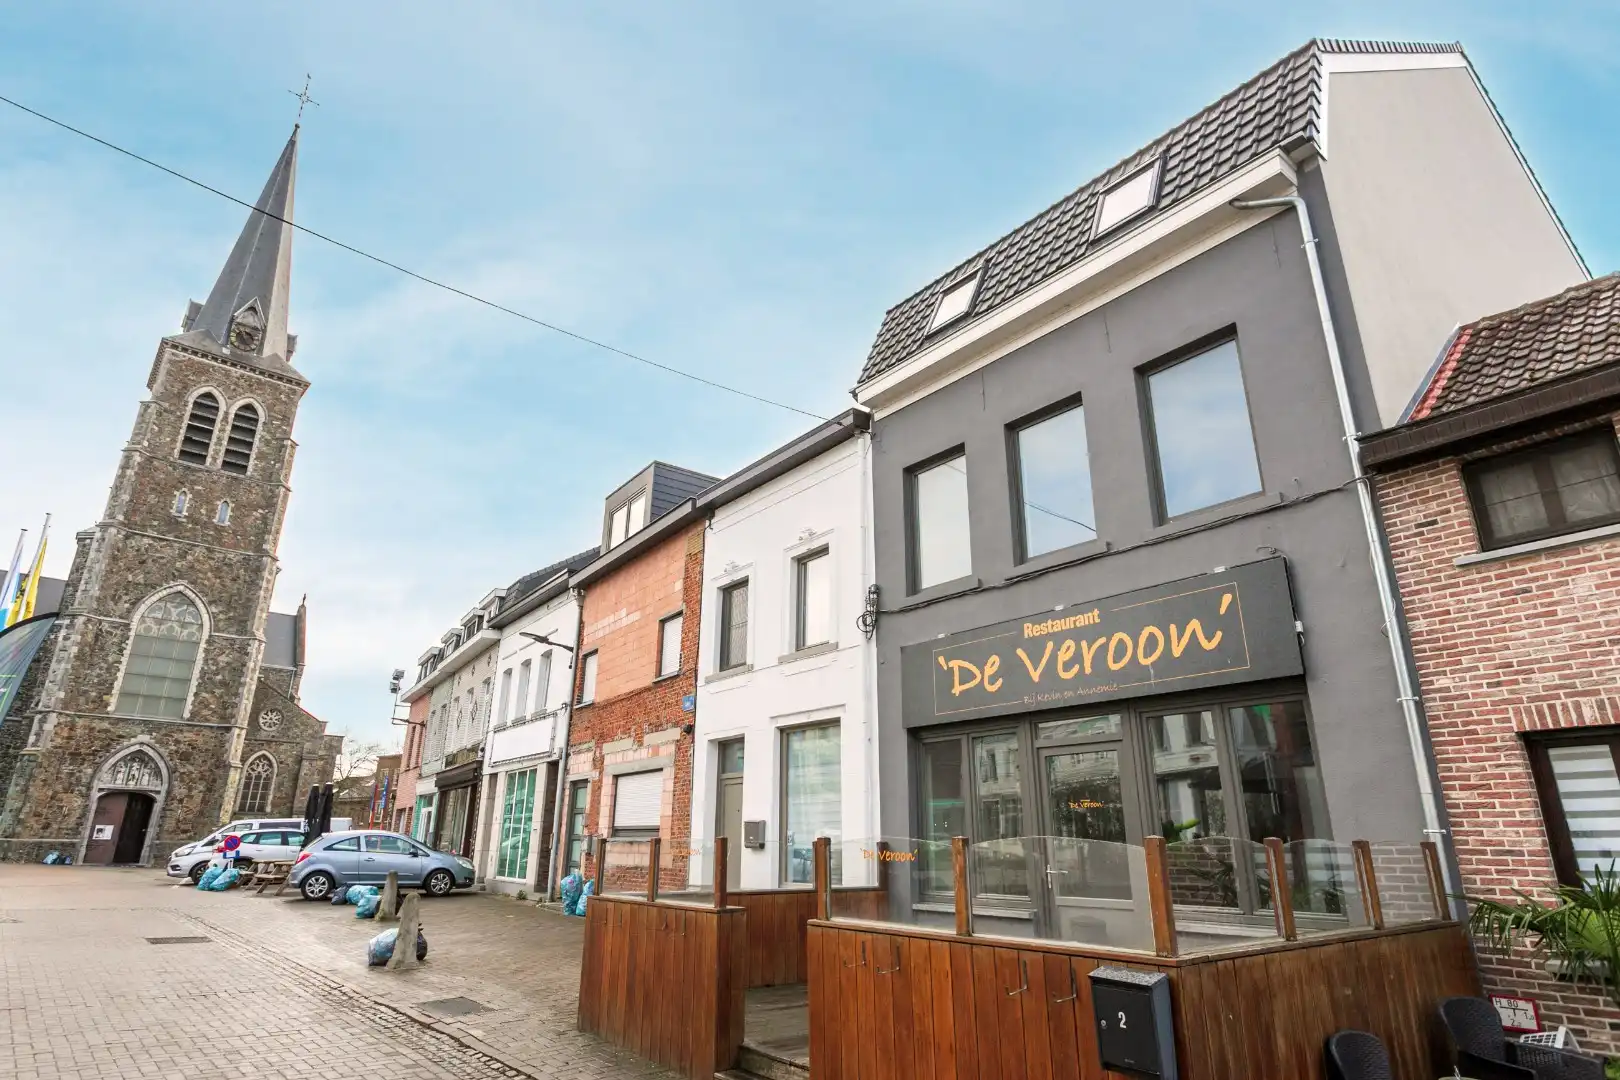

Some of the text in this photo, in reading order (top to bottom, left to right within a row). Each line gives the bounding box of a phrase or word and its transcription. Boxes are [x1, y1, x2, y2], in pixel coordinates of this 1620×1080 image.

[1023, 608, 1100, 639] Restaurant
[1023, 692, 1036, 706] Bij
[1063, 690, 1075, 699] en
[1077, 681, 1119, 696] Annemie
[1494, 998, 1502, 1006] H
[1118, 1011, 1127, 1029] 2
